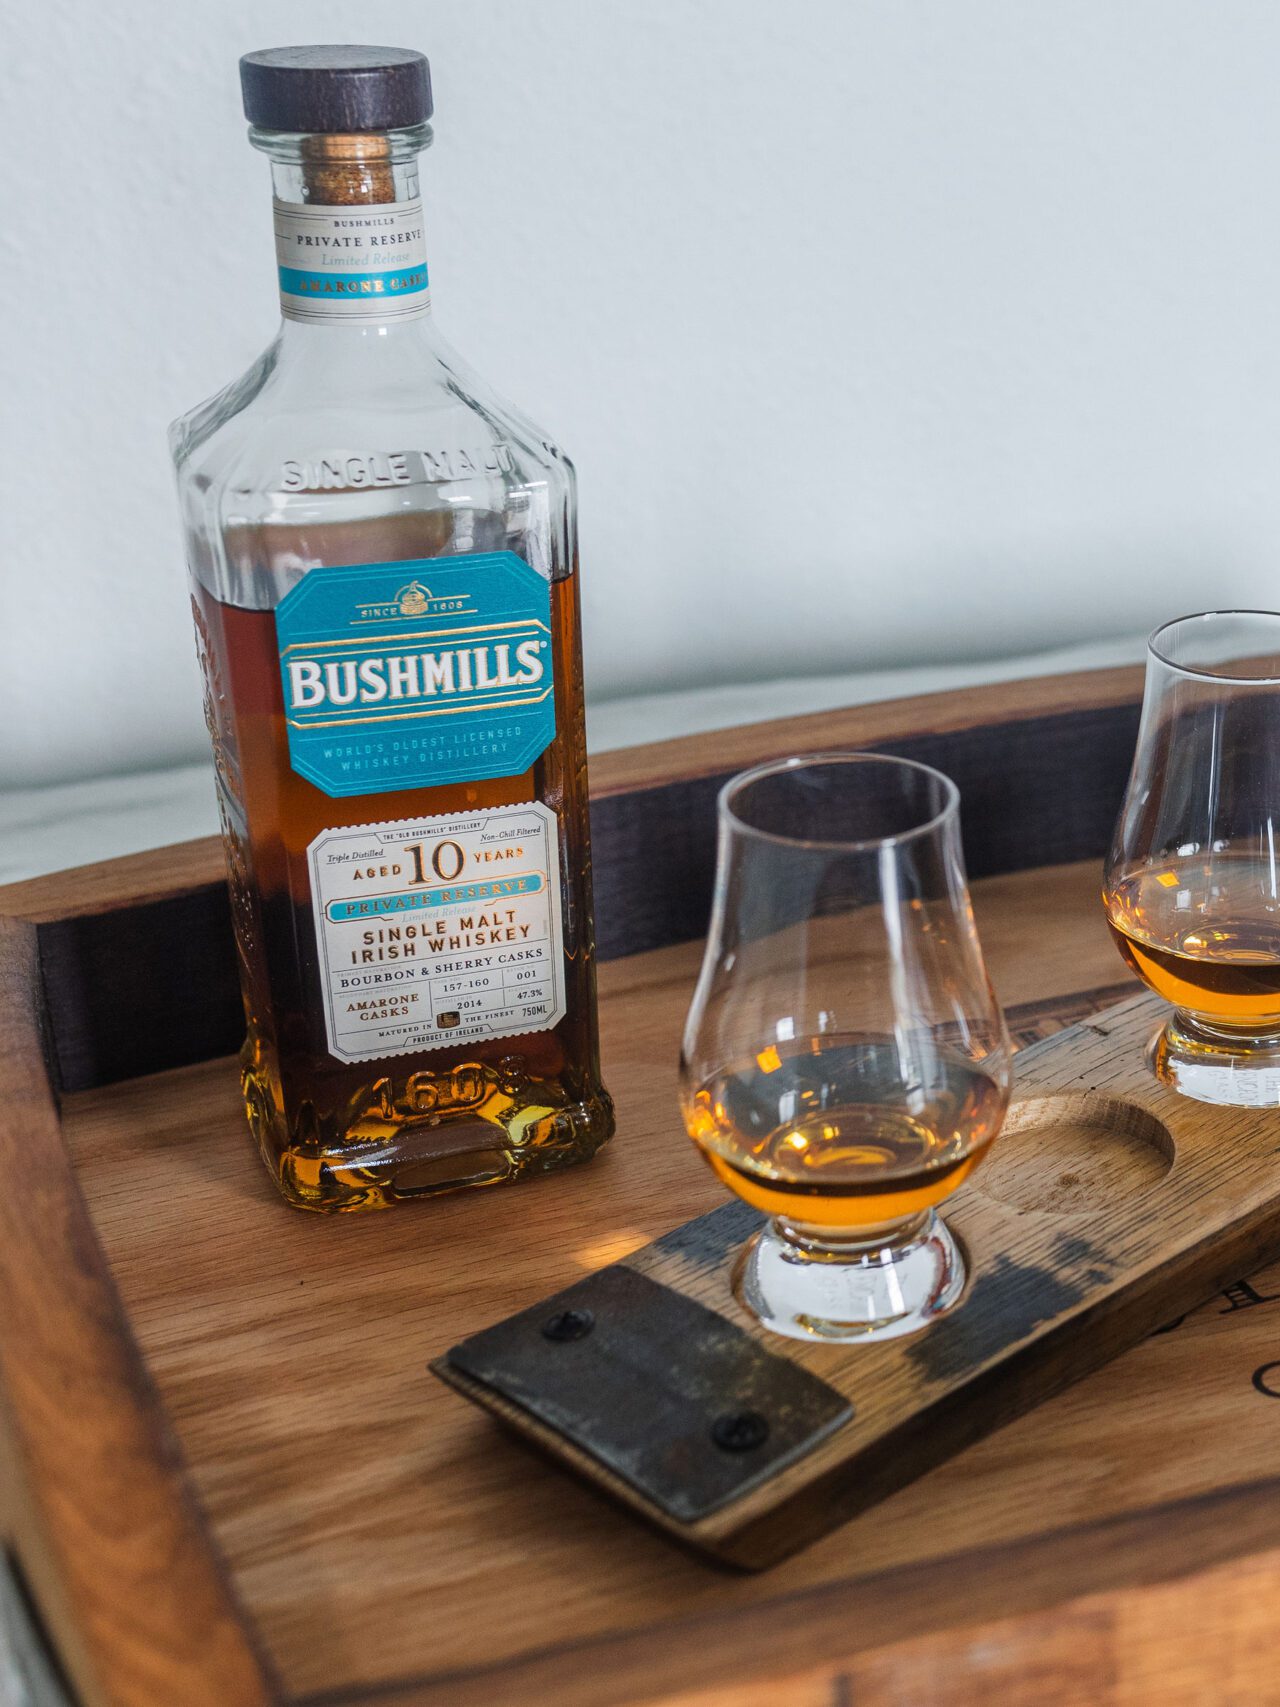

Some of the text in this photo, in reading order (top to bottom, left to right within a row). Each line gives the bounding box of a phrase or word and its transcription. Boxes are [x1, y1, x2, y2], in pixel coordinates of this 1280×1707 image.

[334, 217, 395, 228] BUSHMILLS
[296, 229, 421, 247] PRIVATE RESERVE
[321, 252, 409, 266] Limited Release
[299, 279, 385, 293] AMARONE
[281, 453, 411, 493] SINGLE
[360, 607, 398, 618] SINCE
[287, 640, 545, 709] BUSHMILLS
[323, 726, 521, 759] WORLD'S OLDEST LICENSED
[340, 743, 508, 770] WHISKEY DISTILLERY
[448, 822, 481, 832] DISTILLERY
[480, 826, 541, 841] Non-Chill Filtered
[327, 849, 384, 864] Triple Distilled
[353, 839, 524, 885] AGED 10 YEARS
[346, 880, 527, 915] PRIVATE RESERVE
[363, 920, 446, 945] SINGLE
[460, 910, 517, 931] MALT
[351, 942, 416, 965] IRISH
[428, 924, 531, 953] WHISKEY
[340, 969, 415, 988] BOURBON
[421, 967, 430, 976] &
[435, 956, 493, 974] SHERRY
[498, 948, 543, 964] CASKS
[516, 970, 537, 980] 001
[443, 978, 489, 992] 157-160
[517, 988, 543, 999] 47.3%
[346, 993, 420, 1012] AMARONE
[457, 999, 482, 1010] 2014
[522, 1004, 547, 1017] 750ML
[360, 1006, 409, 1021] CASKS
[378, 1025, 419, 1037] MATURED
[485, 1010, 515, 1020] FINEST
[412, 1027, 484, 1044] PRODUCT OF IRELAND
[372, 1054, 527, 1119] 1608
